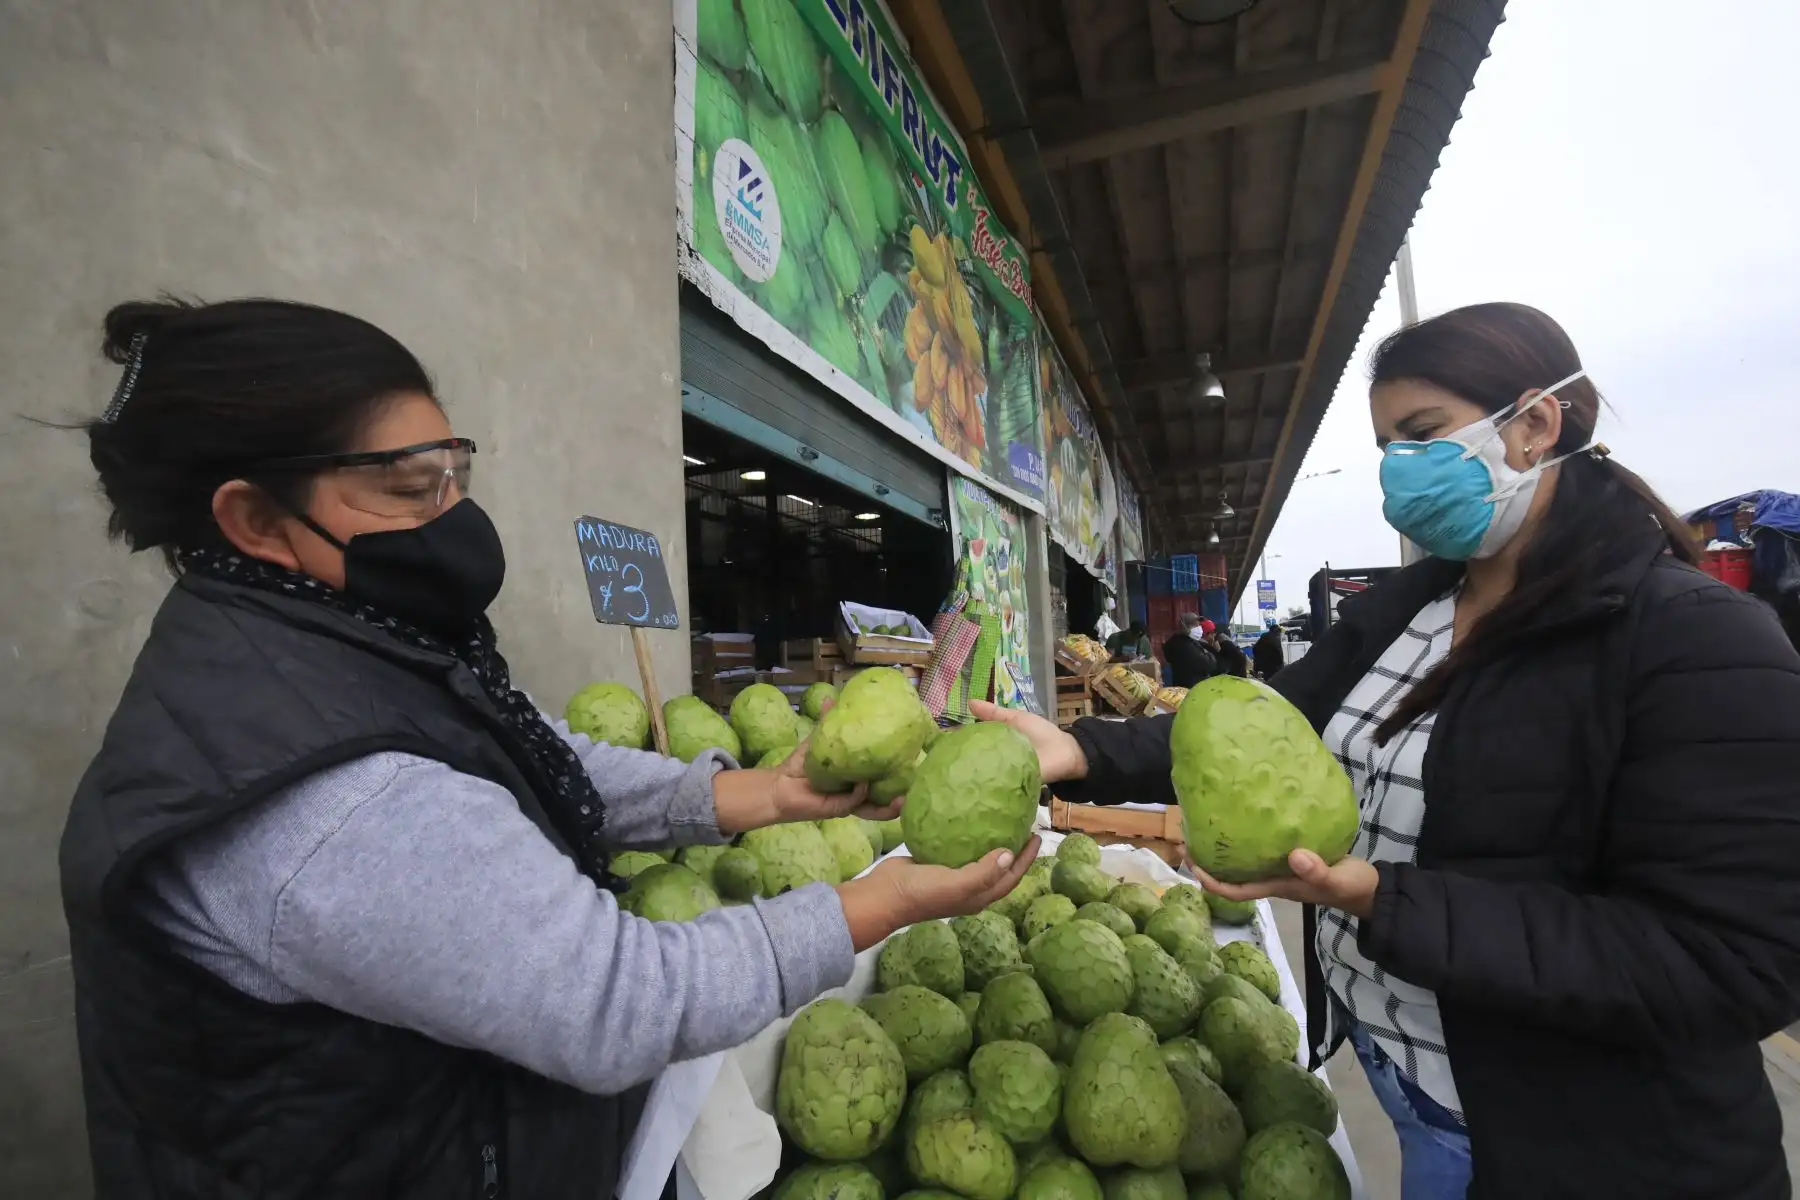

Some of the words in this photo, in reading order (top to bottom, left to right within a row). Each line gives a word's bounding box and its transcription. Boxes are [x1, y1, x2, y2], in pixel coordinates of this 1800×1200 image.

[725, 199, 770, 250] EMMSA
[578, 520, 660, 558] MADURA
[585, 552, 619, 572] KILO
